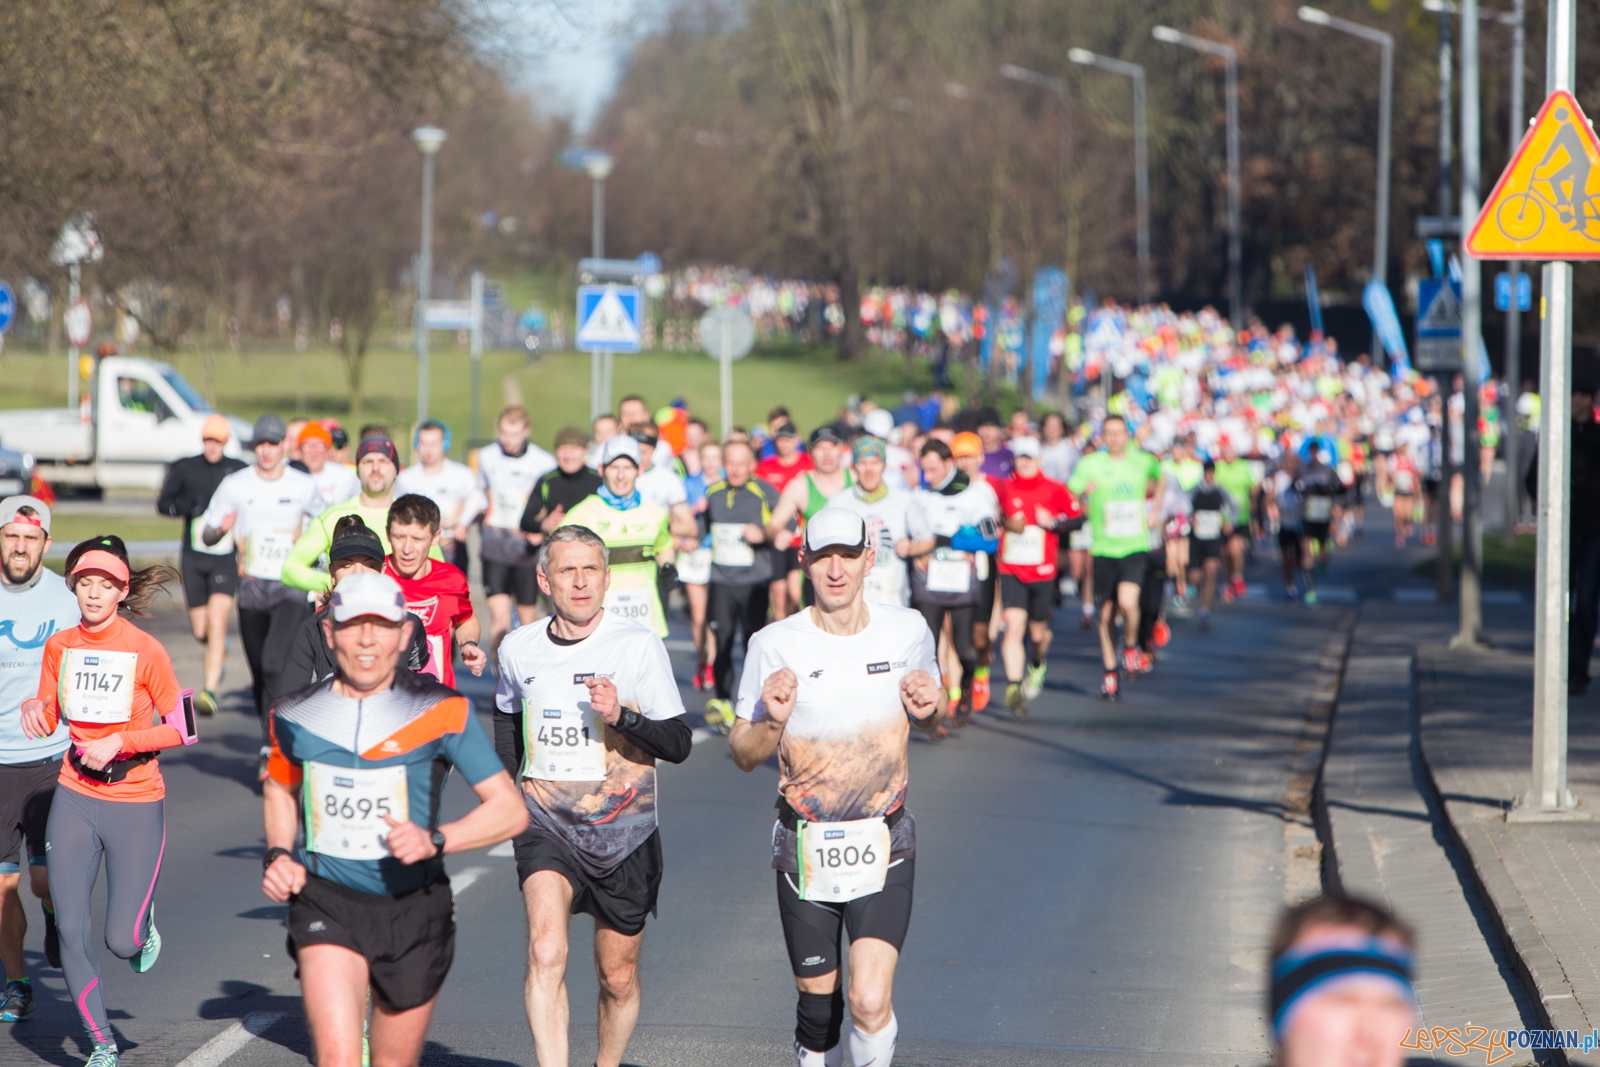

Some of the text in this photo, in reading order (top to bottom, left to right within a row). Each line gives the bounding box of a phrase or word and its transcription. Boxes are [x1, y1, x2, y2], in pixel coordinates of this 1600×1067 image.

[75, 671, 123, 692] 11147
[537, 725, 589, 747] 4581
[325, 794, 391, 819] 8695
[815, 844, 876, 868] 1806
